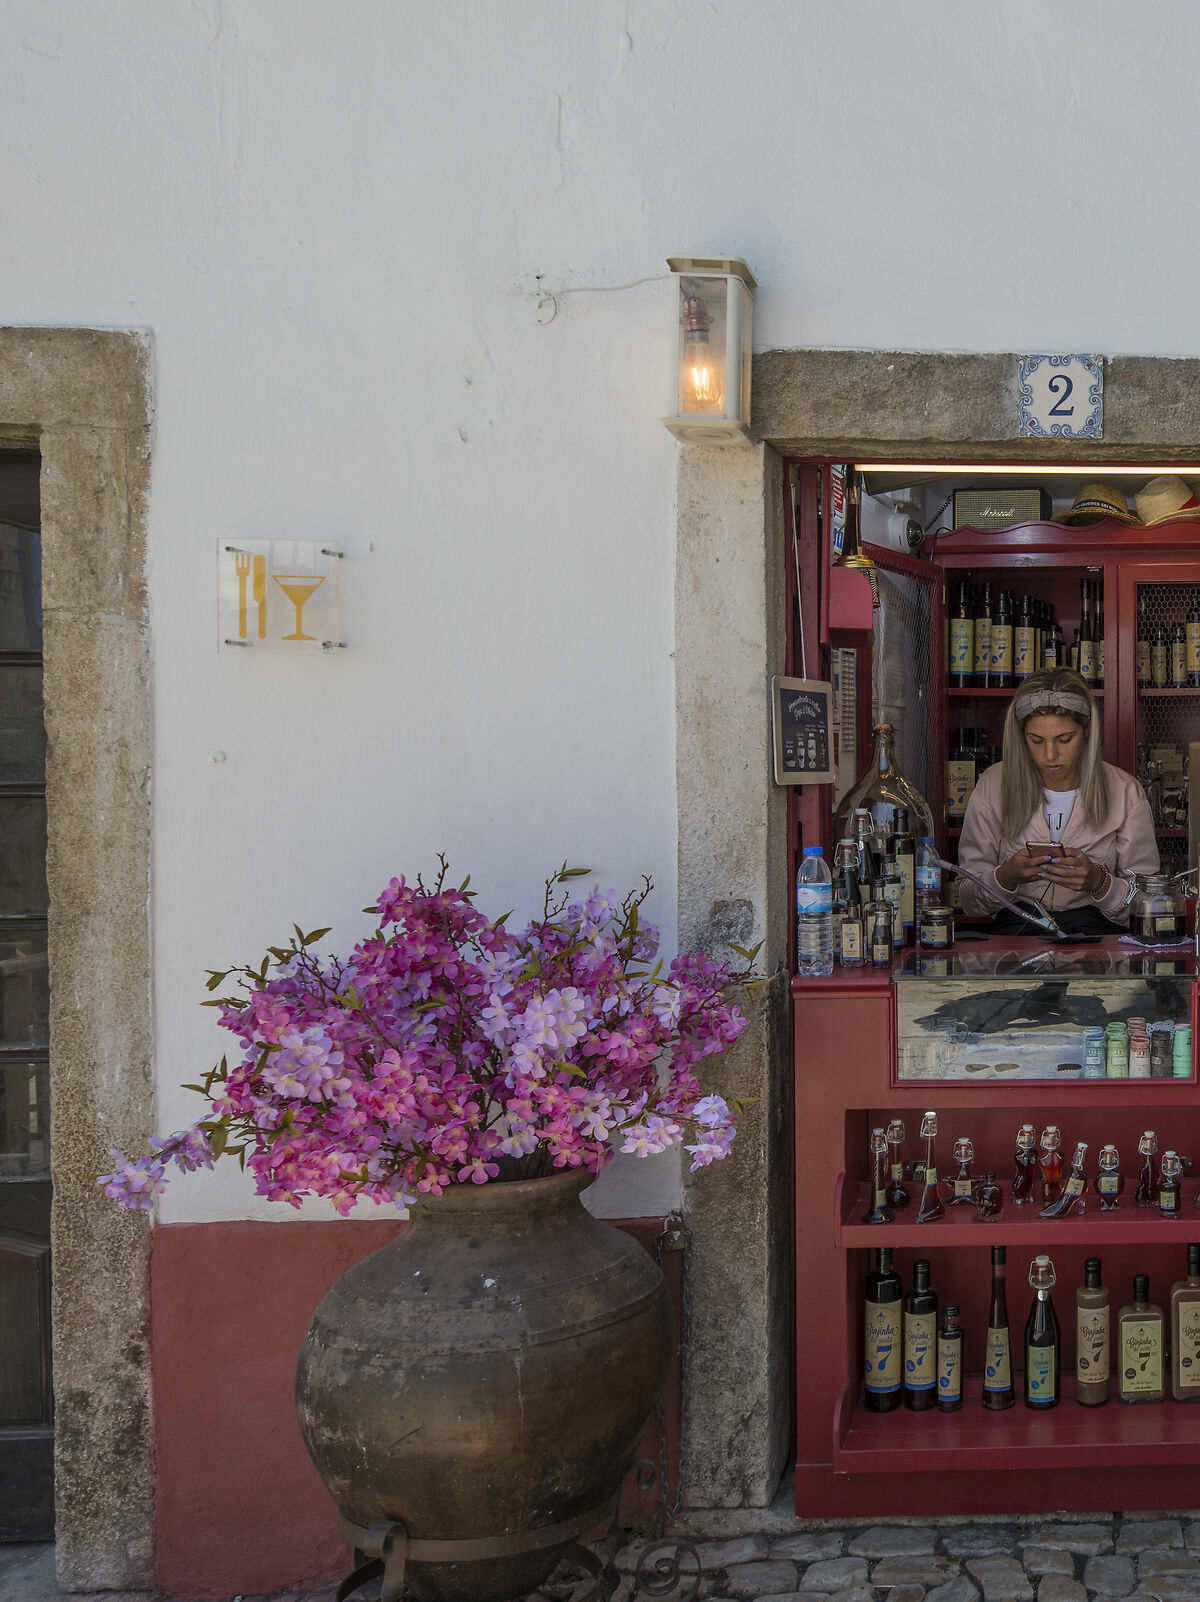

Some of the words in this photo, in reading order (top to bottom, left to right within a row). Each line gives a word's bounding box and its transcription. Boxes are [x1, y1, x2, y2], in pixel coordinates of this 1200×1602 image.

[1048, 374, 1074, 416] 2
[980, 506, 1016, 517] Marshall
[958, 788, 966, 803] 7
[865, 1322, 898, 1338] Ginjinha
[908, 1330, 932, 1342] Ginjinha
[1080, 1325, 1108, 1338] Ginjinha
[1127, 1336, 1156, 1350] Ginjinha
[877, 1344, 892, 1370] 7
[916, 1346, 927, 1366] 7
[1092, 1342, 1104, 1362] 7
[995, 1353, 1004, 1368] 7
[1139, 1352, 1150, 1372] 7
[946, 1363, 955, 1377] 7
[1040, 1370, 1048, 1384] 7
